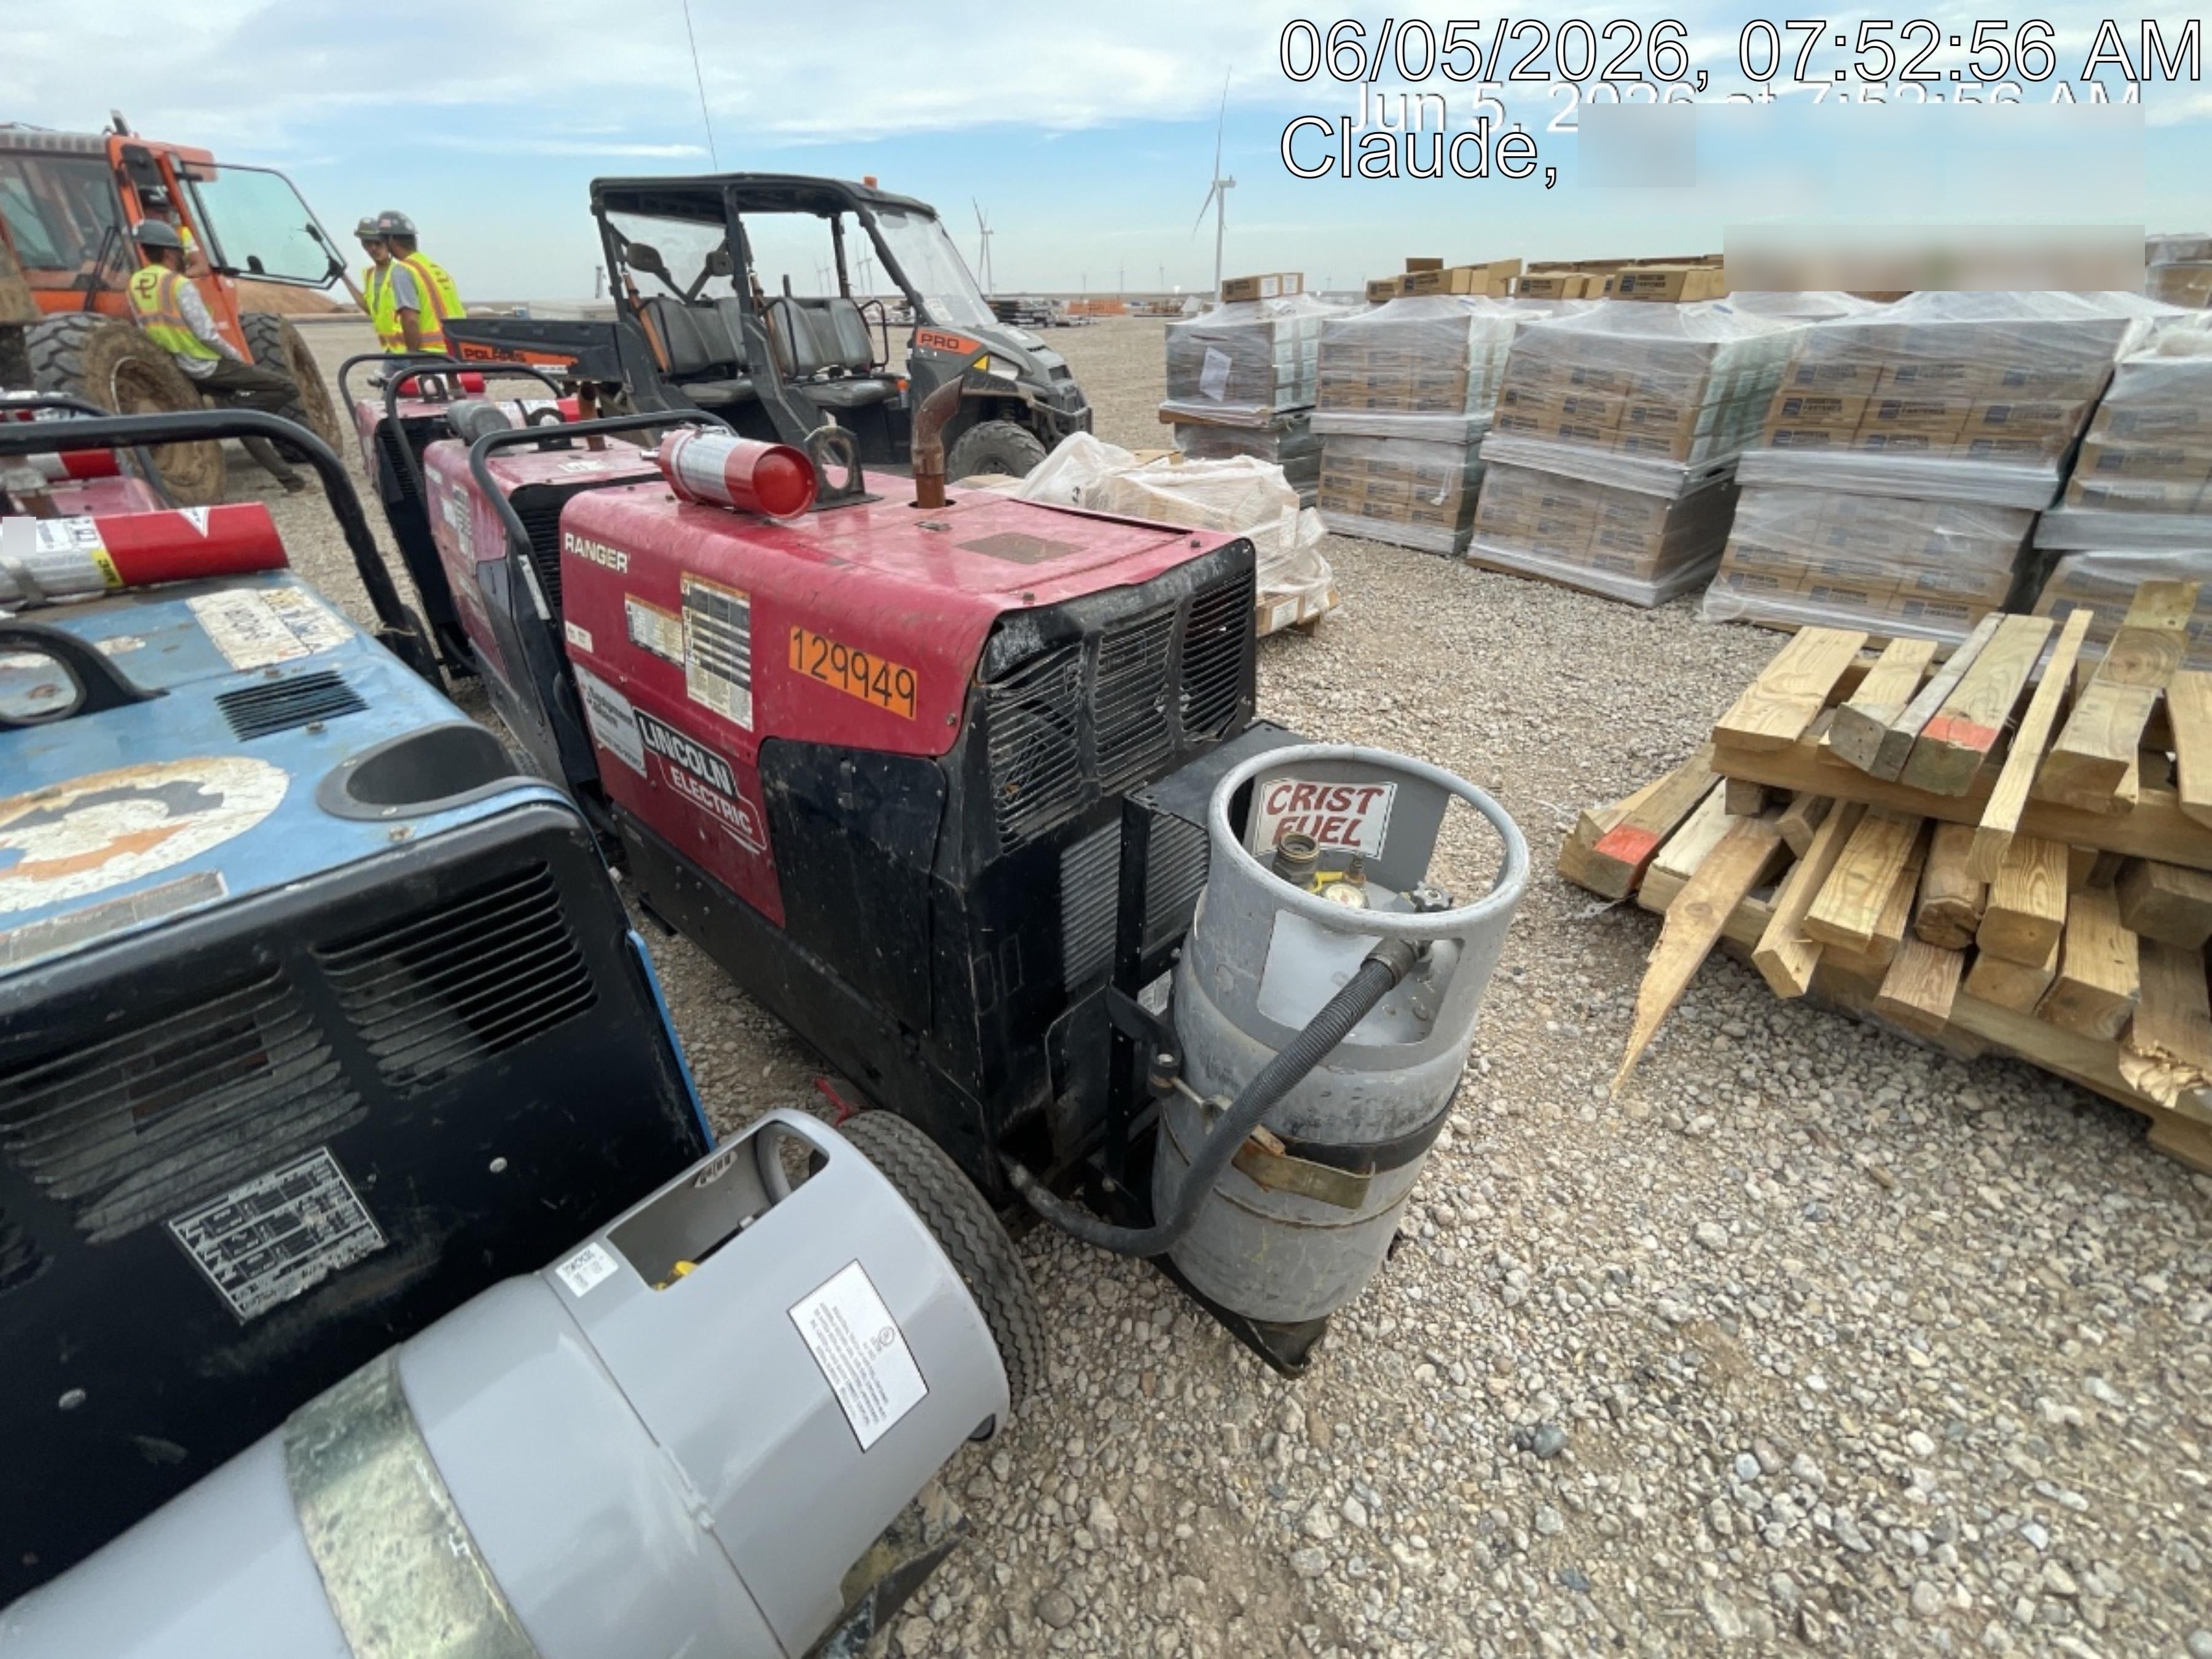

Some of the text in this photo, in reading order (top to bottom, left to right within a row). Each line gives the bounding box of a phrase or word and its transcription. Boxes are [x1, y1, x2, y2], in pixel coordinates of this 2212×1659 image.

[922, 334, 959, 349] PRO
[565, 531, 628, 574] RANGER
[794, 629, 915, 718] 129949
[638, 715, 734, 796] LINCOLN
[670, 766, 753, 835] ELECTRIC
[1266, 783, 1384, 815] CRIST
[1272, 814, 1363, 847] FUEL
